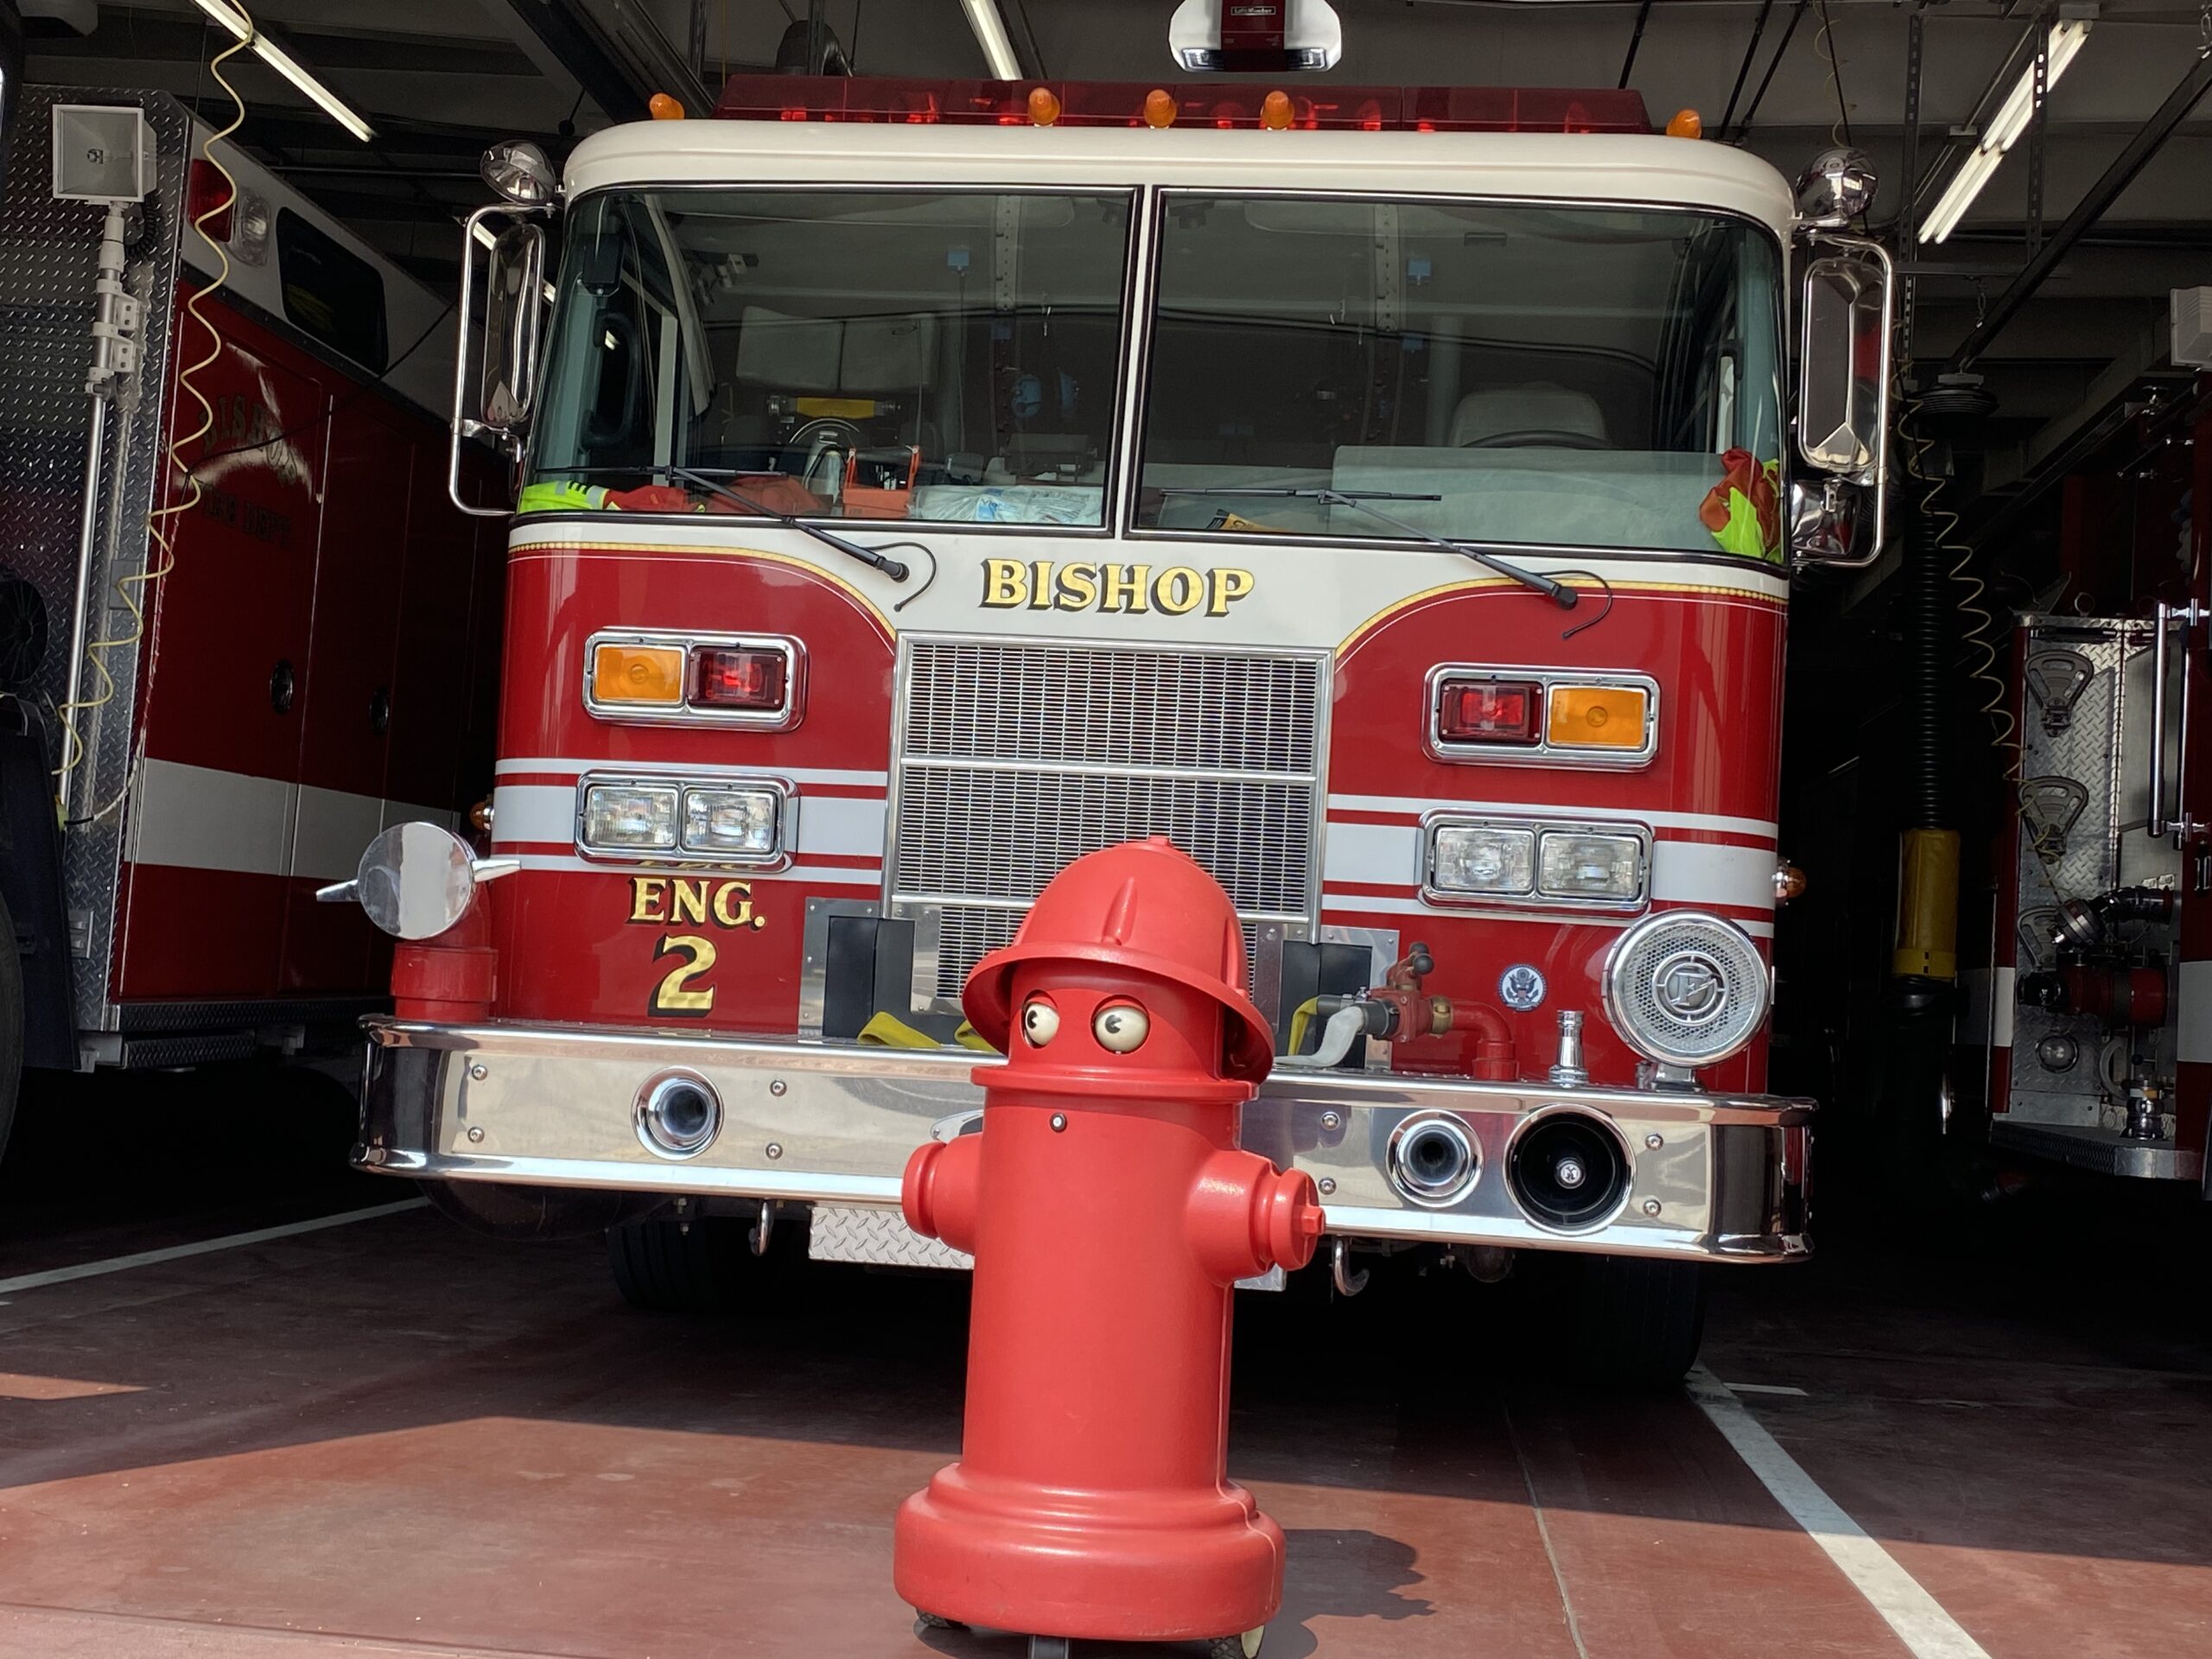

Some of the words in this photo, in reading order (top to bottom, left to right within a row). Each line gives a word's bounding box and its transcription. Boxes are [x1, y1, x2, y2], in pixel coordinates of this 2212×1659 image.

[980, 558, 1255, 617] BISHOP
[628, 877, 766, 931] ENG.
[648, 933, 716, 1017] 2
